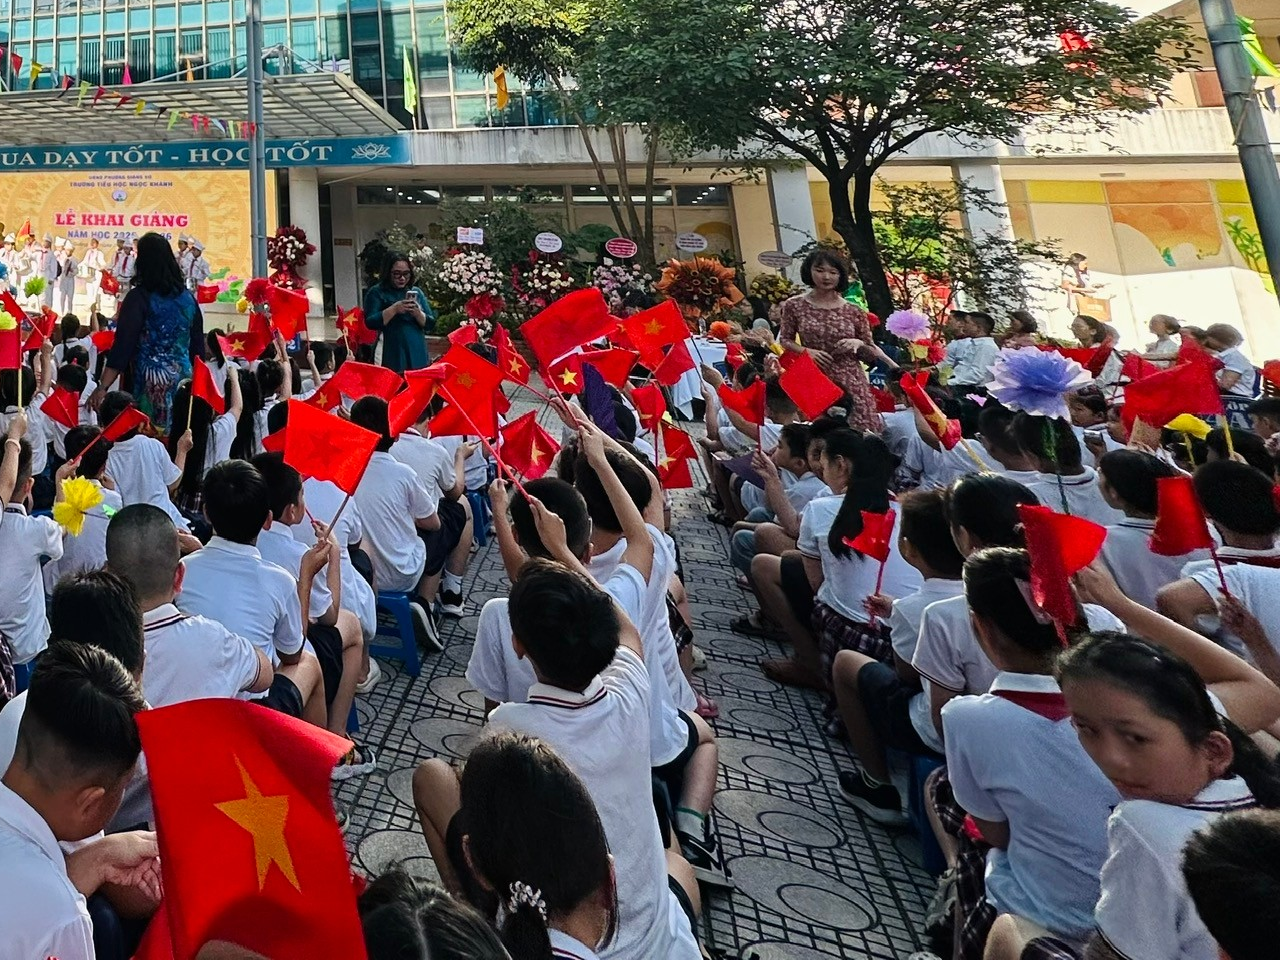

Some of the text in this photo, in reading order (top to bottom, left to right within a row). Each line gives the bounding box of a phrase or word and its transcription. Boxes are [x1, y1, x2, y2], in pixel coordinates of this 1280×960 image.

[43, 150, 98, 168] DẠY
[105, 144, 163, 164] TỐT
[188, 147, 250, 166] HỌC
[265, 140, 333, 162] TỐT
[55, 208, 188, 228] LỄ KHAI GIẢNG
[67, 230, 88, 239] NĂM
[91, 231, 111, 241] HỌC
